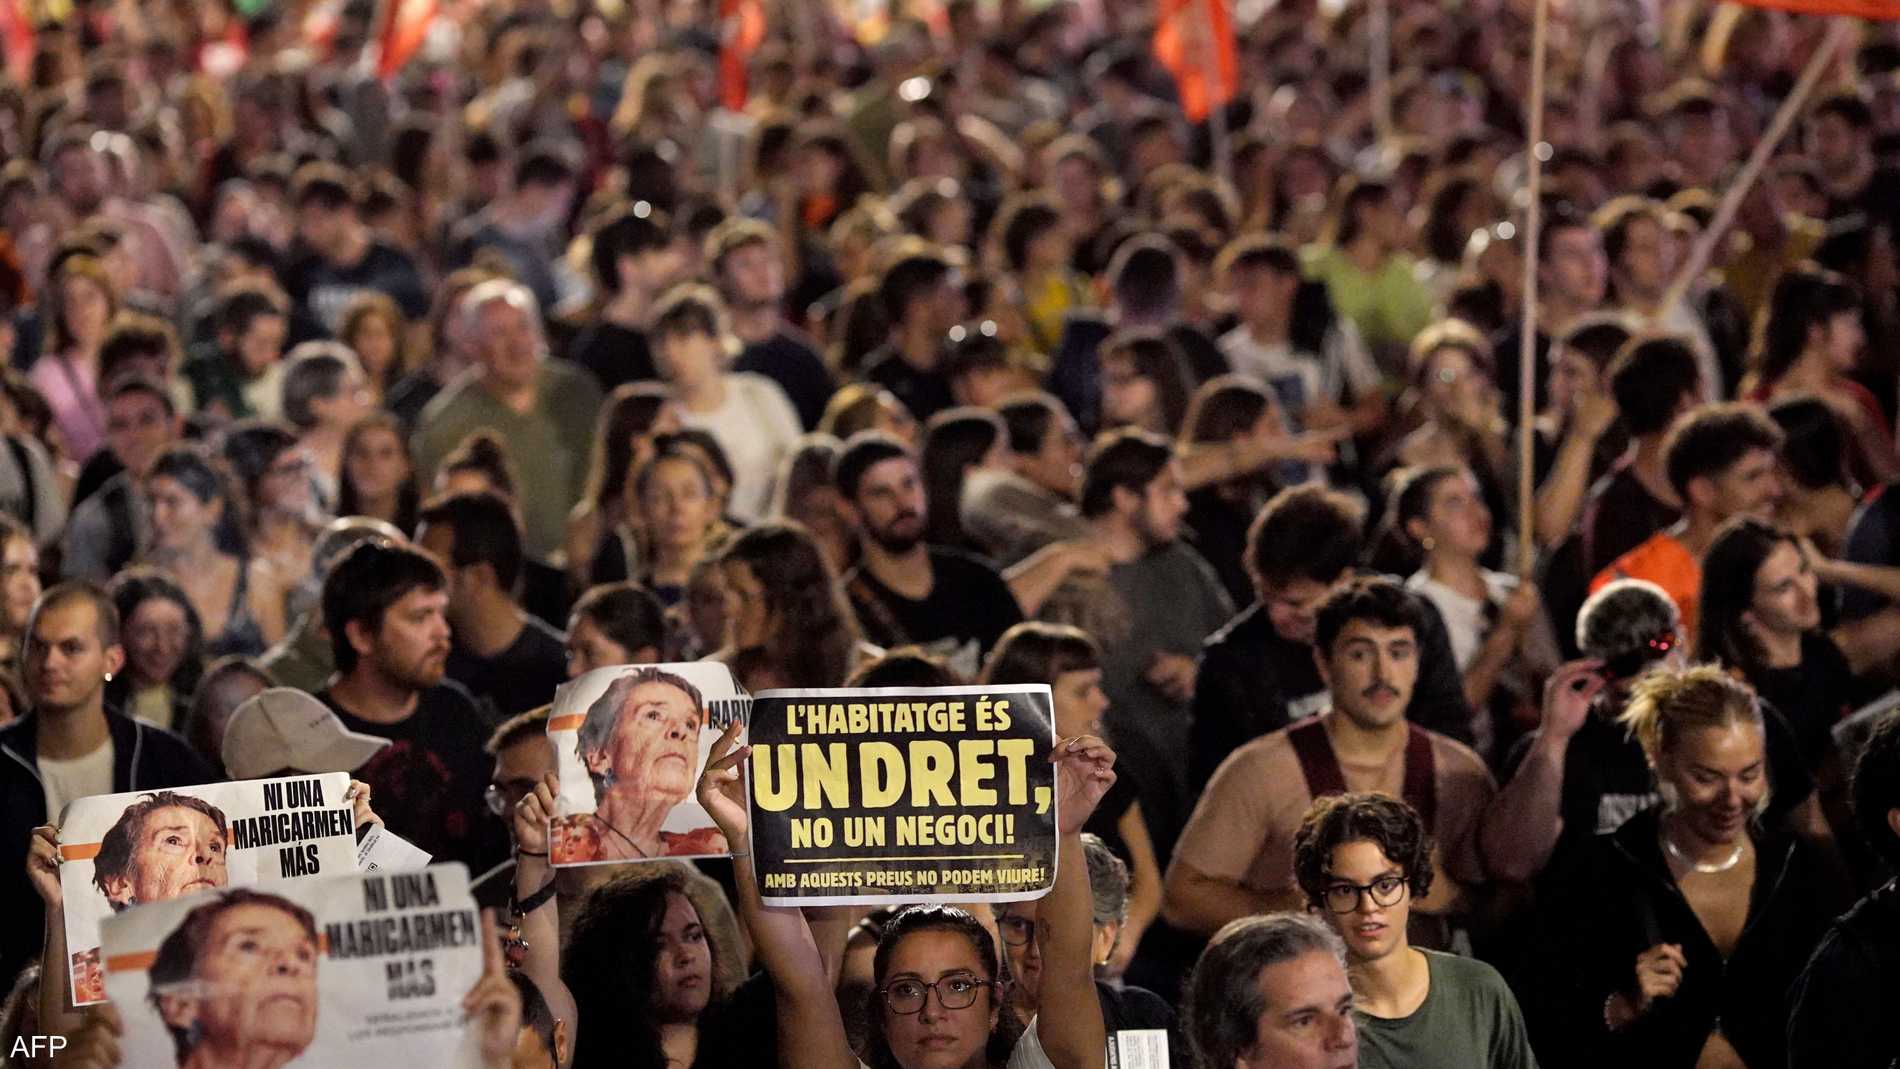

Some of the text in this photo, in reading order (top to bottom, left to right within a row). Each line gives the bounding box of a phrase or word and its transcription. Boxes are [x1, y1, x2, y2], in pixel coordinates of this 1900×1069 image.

[975, 695, 1012, 731] ÉS
[263, 779, 325, 811] NI UNA
[752, 738, 1051, 815] UN DRET,
[232, 808, 353, 850] MARICARMEN
[791, 814, 1015, 849] NO UN NEGOCI!
[279, 841, 320, 879] MÁS
[765, 867, 1045, 888] AMB AQUESTS PREUS NO PODEM VIURE!
[363, 872, 440, 912] NI UNA
[325, 910, 476, 960] MARICARMEN
